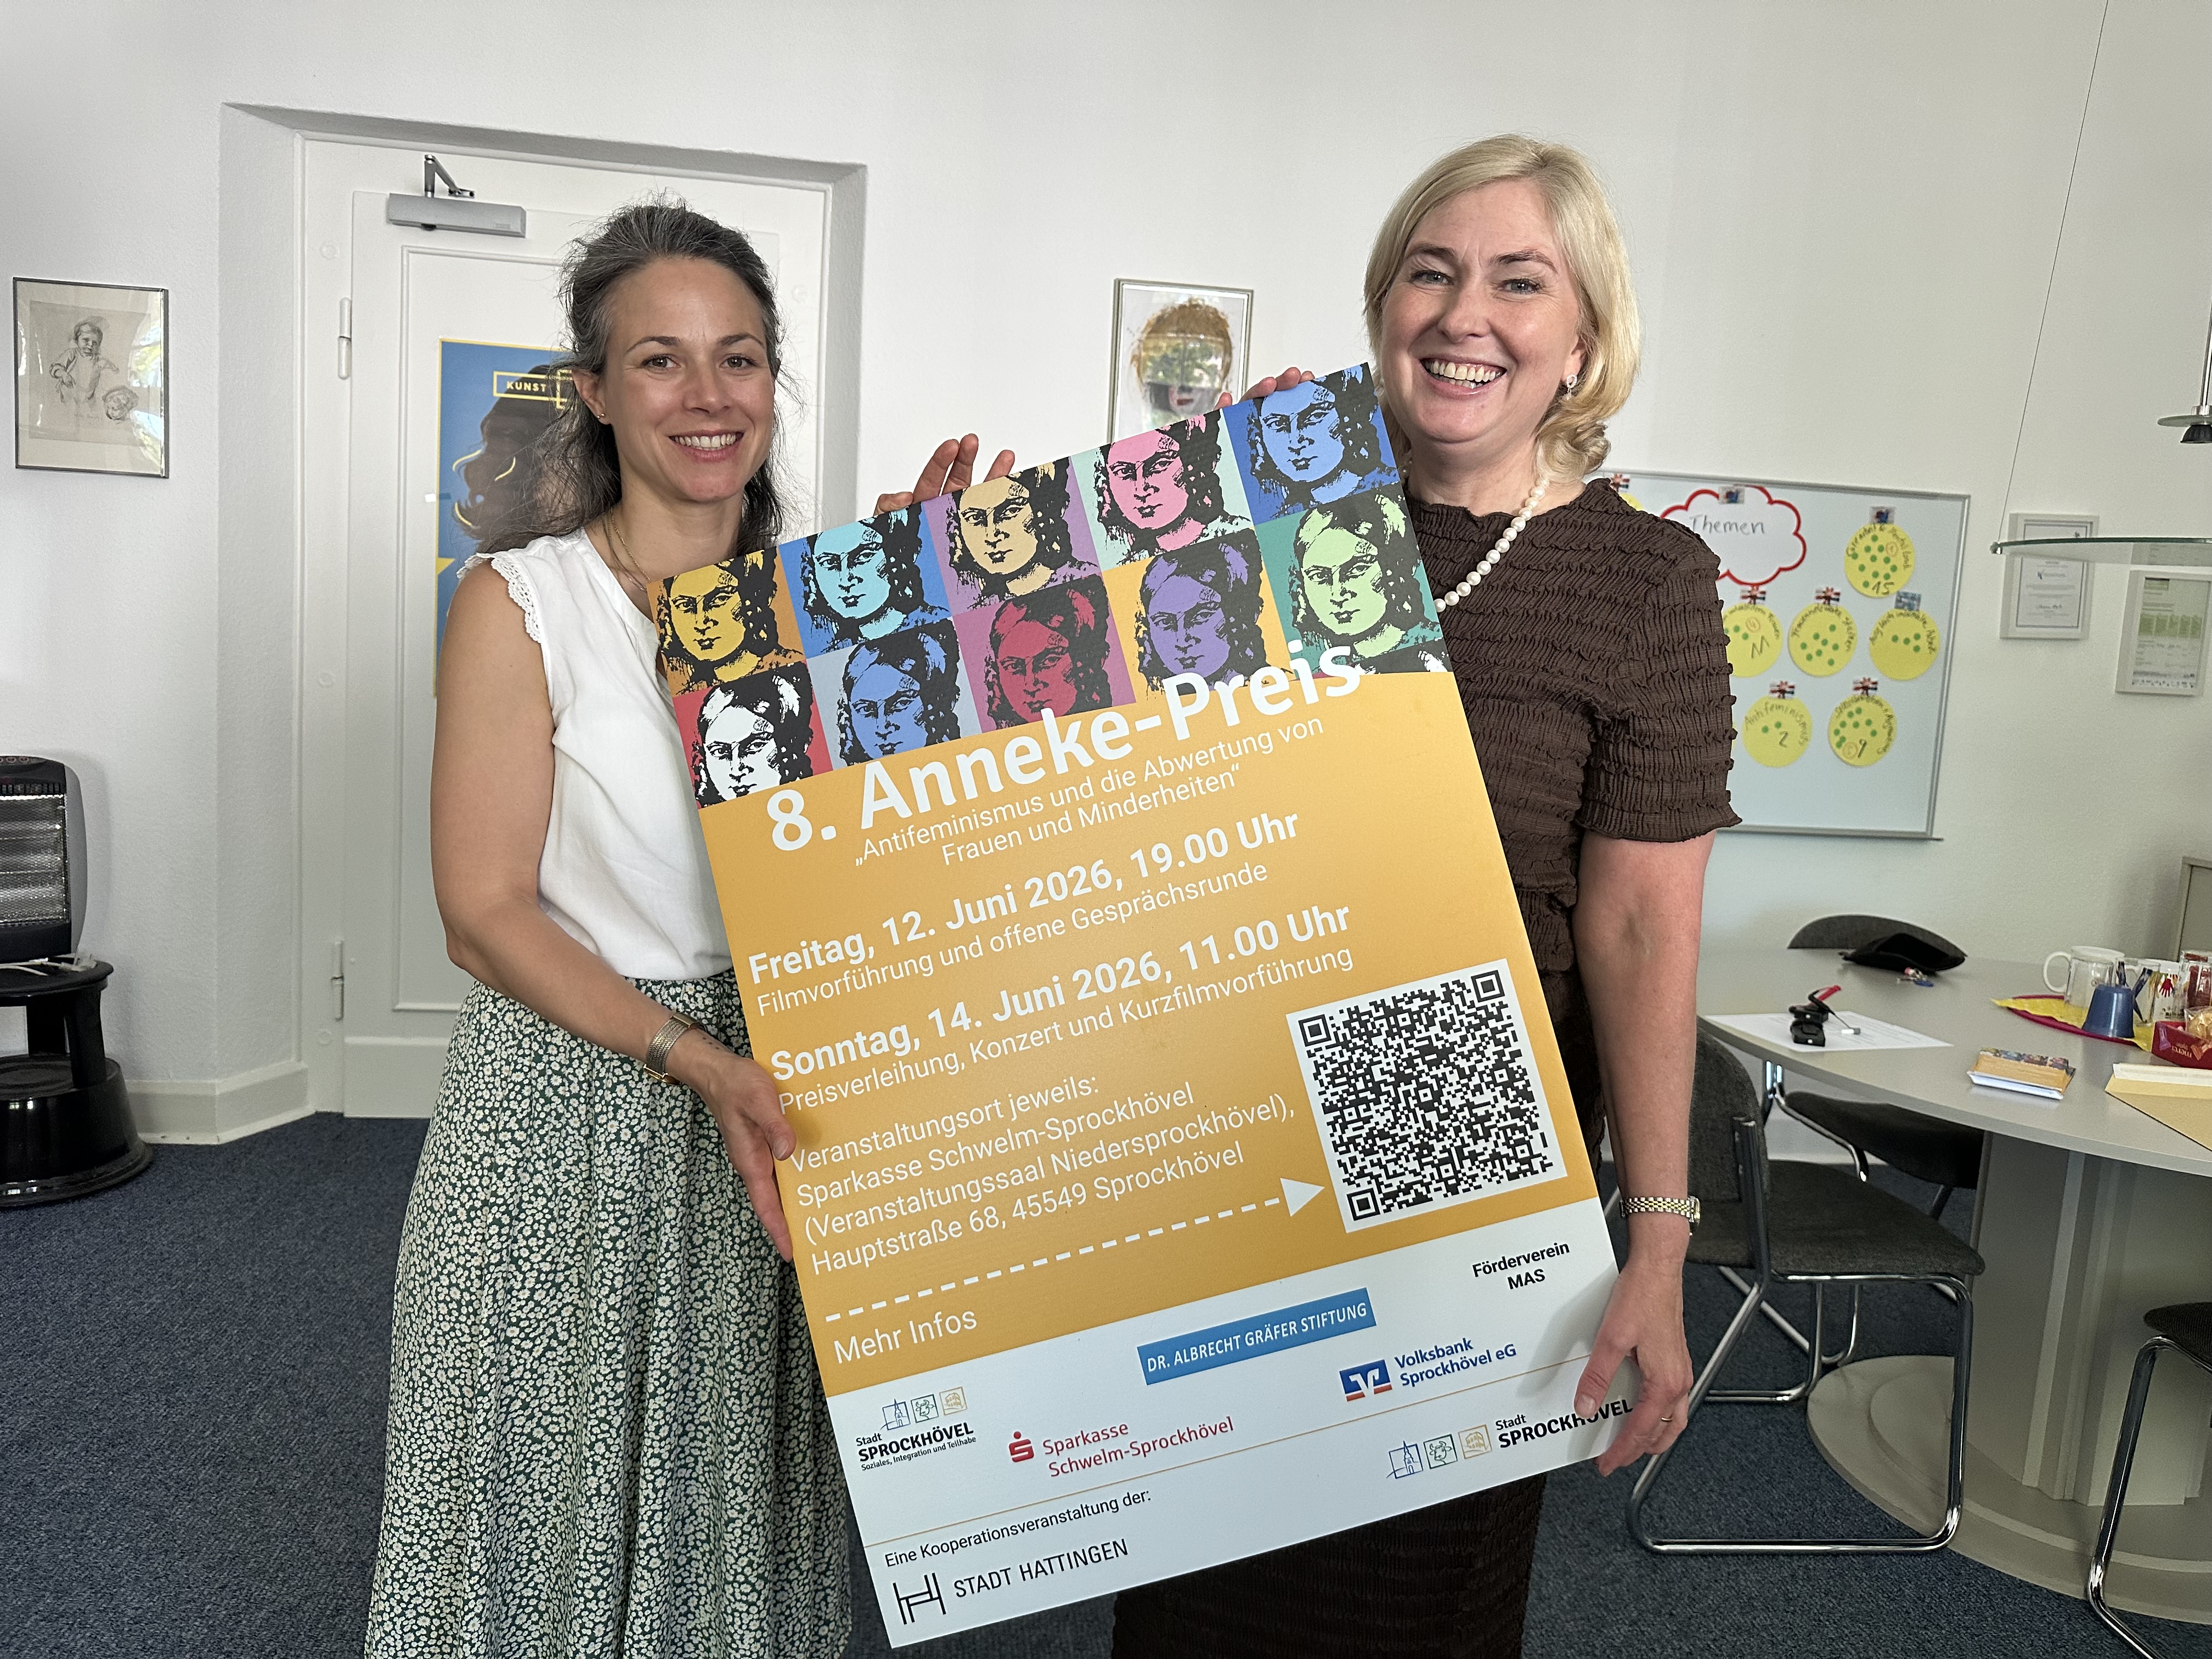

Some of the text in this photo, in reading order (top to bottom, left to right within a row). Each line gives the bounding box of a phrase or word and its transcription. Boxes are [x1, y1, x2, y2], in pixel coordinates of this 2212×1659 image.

[507, 381, 546, 392] KUNST
[1689, 514, 1764, 535] Themen
[1871, 580, 1894, 595] 15
[766, 639, 1361, 851] 8. Anneke-Preis
[1779, 731, 1788, 748] 2
[1859, 738, 1867, 758] 9
[855, 718, 1324, 866] „Antifeminismus und die Abwertung von
[941, 763, 1239, 866] Frauen und Minderheiten“
[748, 812, 1298, 984] Freitag, 12. Juni 2026, 19.00 Uhr
[757, 861, 1268, 1017] Filmvorführung und offene Gesprächsrunde
[771, 905, 1350, 1080] Sonntag, 14. Juni 2026, 11.00 Uhr
[779, 948, 1353, 1114] Preisverleihung, Konzert und Kurzfilmvorführung
[790, 1076, 1099, 1172] Veranstaltungsort jeweils:
[797, 1081, 1194, 1209] Sparkasse Schwelm-Sprockhövel
[805, 1093, 1294, 1246] (Veranstaltungssaal Niedersprockhövel),
[811, 1140, 1244, 1275] Hauptstraße 68, 45549 Sprockhövel
[1472, 1242, 1570, 1278] Förderverein
[1507, 1268, 1545, 1290] MAS
[834, 1311, 977, 1364] Mehr Infos
[1147, 1302, 1367, 1372] DR. ALBRECHT GRÄFER STIFTUNG
[1393, 1337, 1474, 1369] Volksbank
[1400, 1344, 1517, 1387] Sprockhövel eG
[855, 1432, 883, 1447] Stadt
[858, 1422, 974, 1462] SPROCKHÖVEL
[1042, 1424, 1129, 1456] Sparkasse
[1048, 1415, 1234, 1477] Schwelm-Sprockhövel
[1495, 1414, 1527, 1431] Stadt
[861, 1436, 977, 1471] Soziales, Integration und Teilhabe
[884, 1491, 1152, 1567] Eine Kooperationsveranstaltung der:
[953, 1538, 1128, 1598] STADT HATTINGEN
